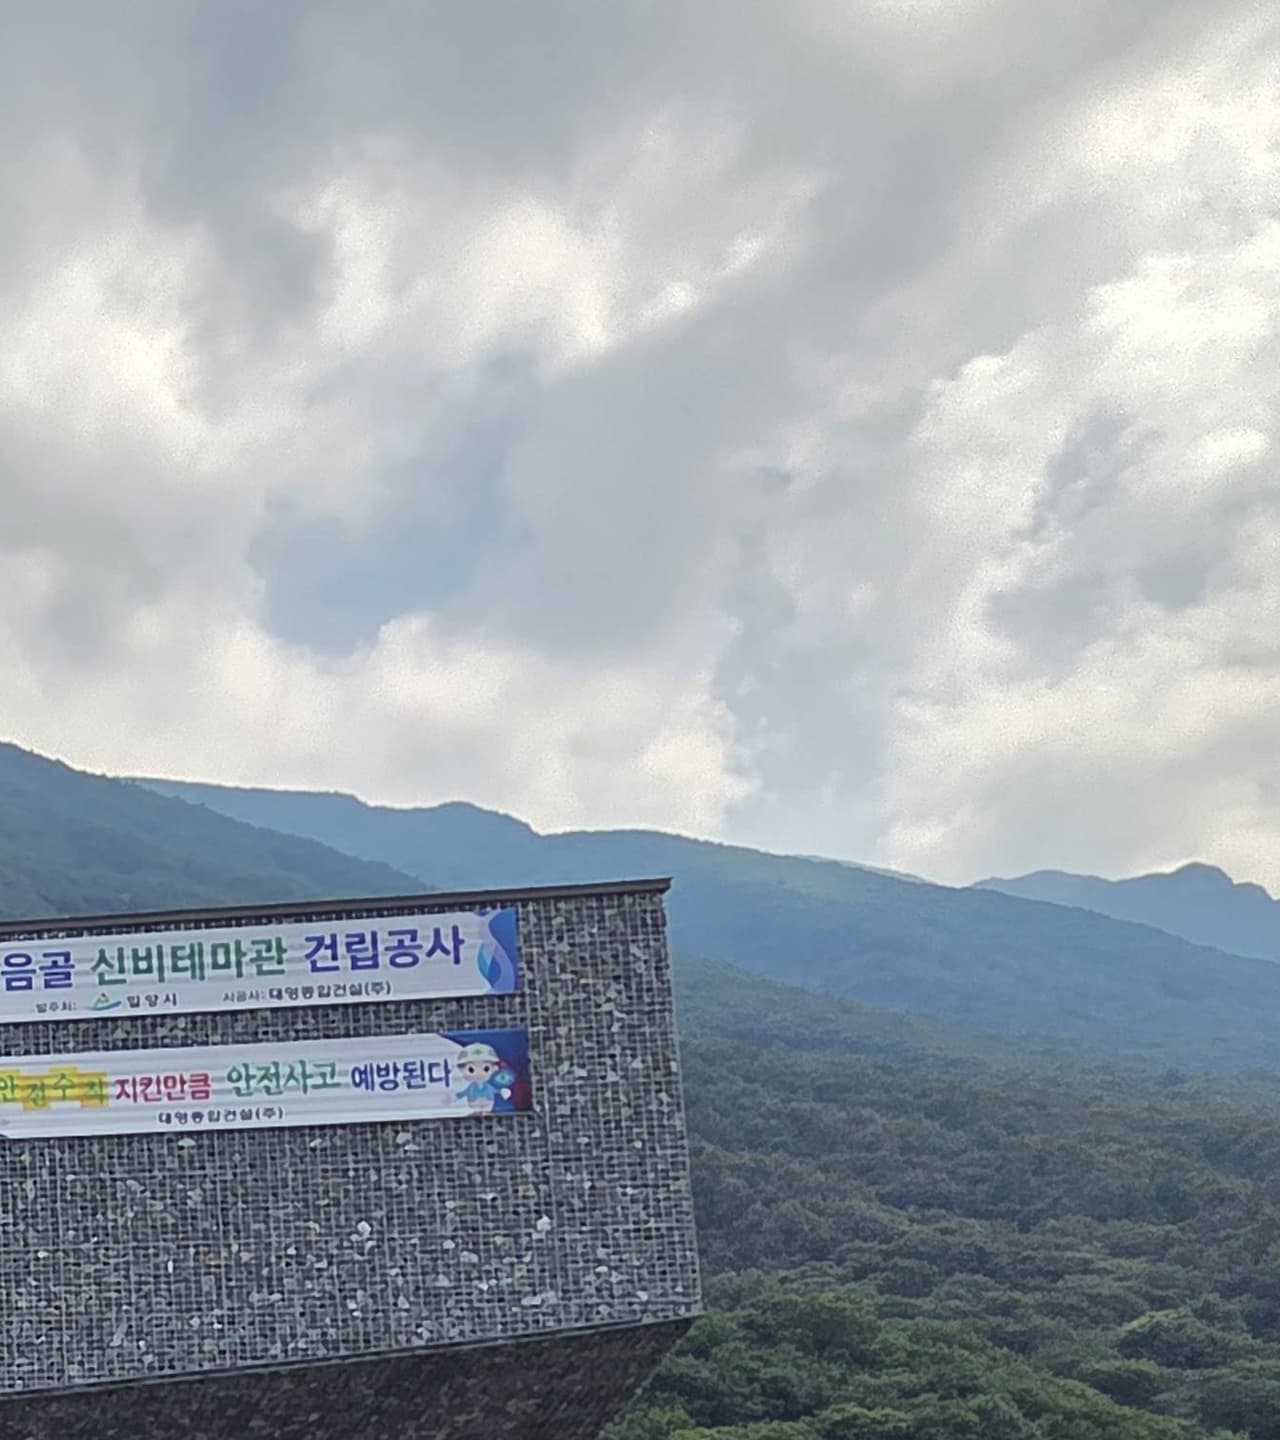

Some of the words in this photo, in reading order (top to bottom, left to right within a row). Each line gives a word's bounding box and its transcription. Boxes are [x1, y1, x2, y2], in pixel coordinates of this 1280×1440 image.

[91, 937, 287, 986] 신비테마관
[304, 925, 465, 973] 건립공사
[115, 1072, 212, 1103] 지킨만큼
[226, 1059, 340, 1098] 안전사고
[351, 1058, 451, 1092] 예방된다
